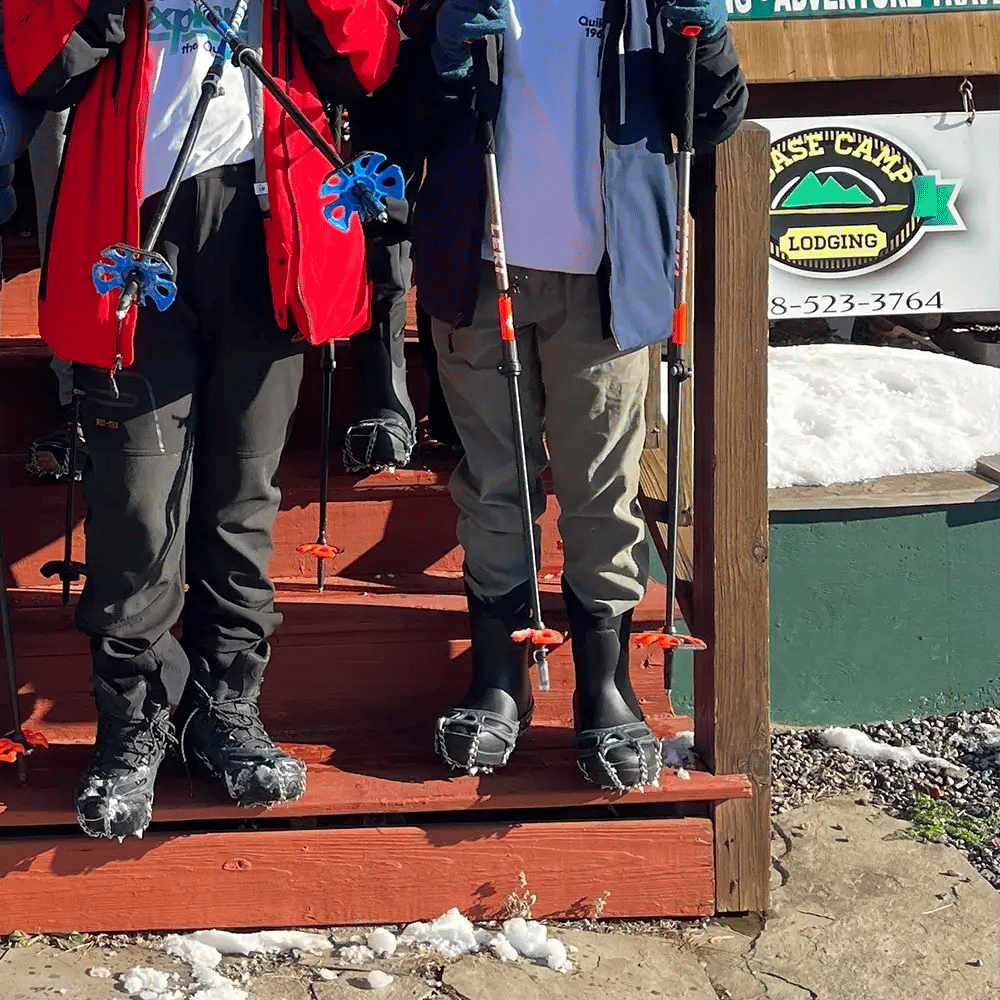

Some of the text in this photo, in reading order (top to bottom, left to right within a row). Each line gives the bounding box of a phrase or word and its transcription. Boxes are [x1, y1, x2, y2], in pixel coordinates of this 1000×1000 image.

[769, 132, 914, 184] ASE CAMP
[788, 233, 879, 252] LODGING
